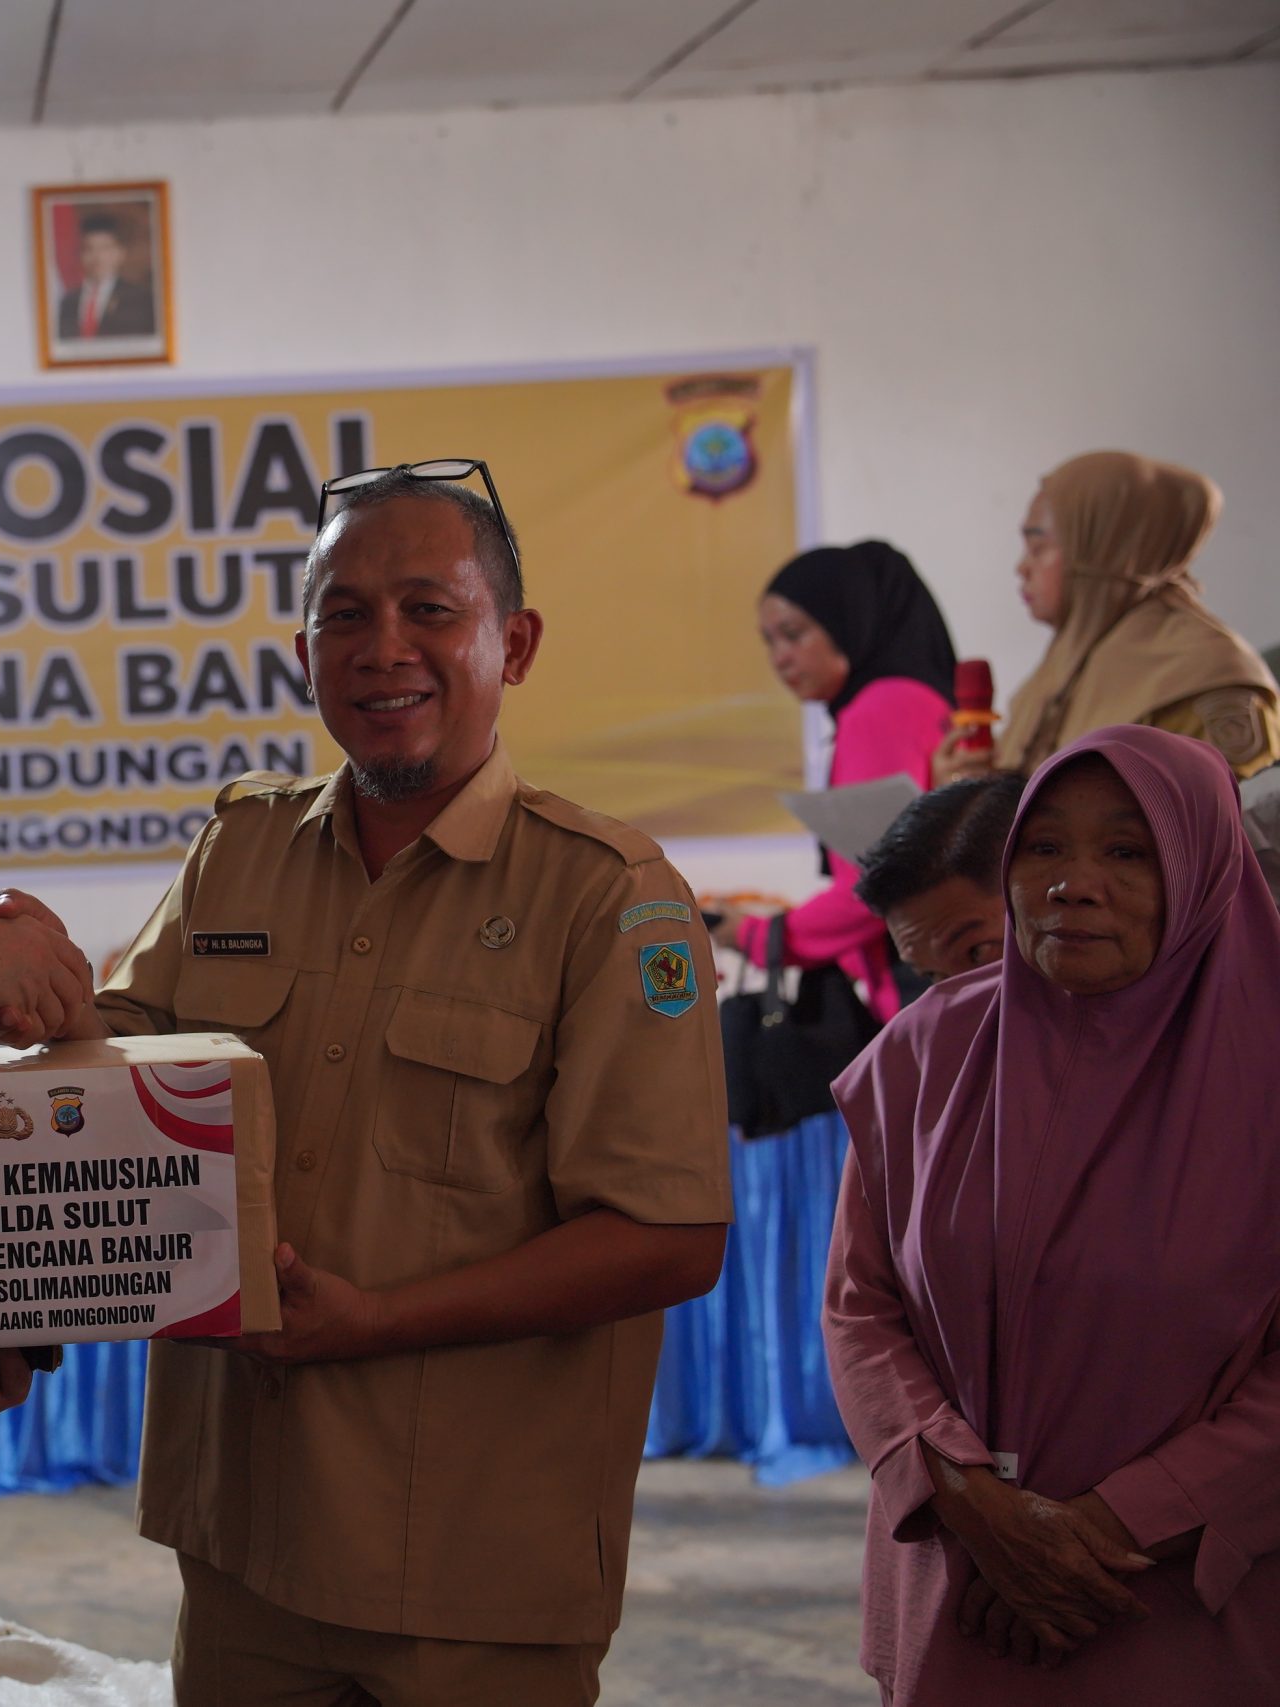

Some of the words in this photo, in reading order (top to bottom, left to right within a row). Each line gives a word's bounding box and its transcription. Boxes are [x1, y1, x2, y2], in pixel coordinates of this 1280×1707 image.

[228, 938, 263, 950] BALONGKA
[3, 1154, 200, 1196] KEMANUSIAAN
[63, 1198, 150, 1230] SULUT
[101, 1232, 192, 1264] BANJIR
[48, 1304, 156, 1328] MONGONDOW
